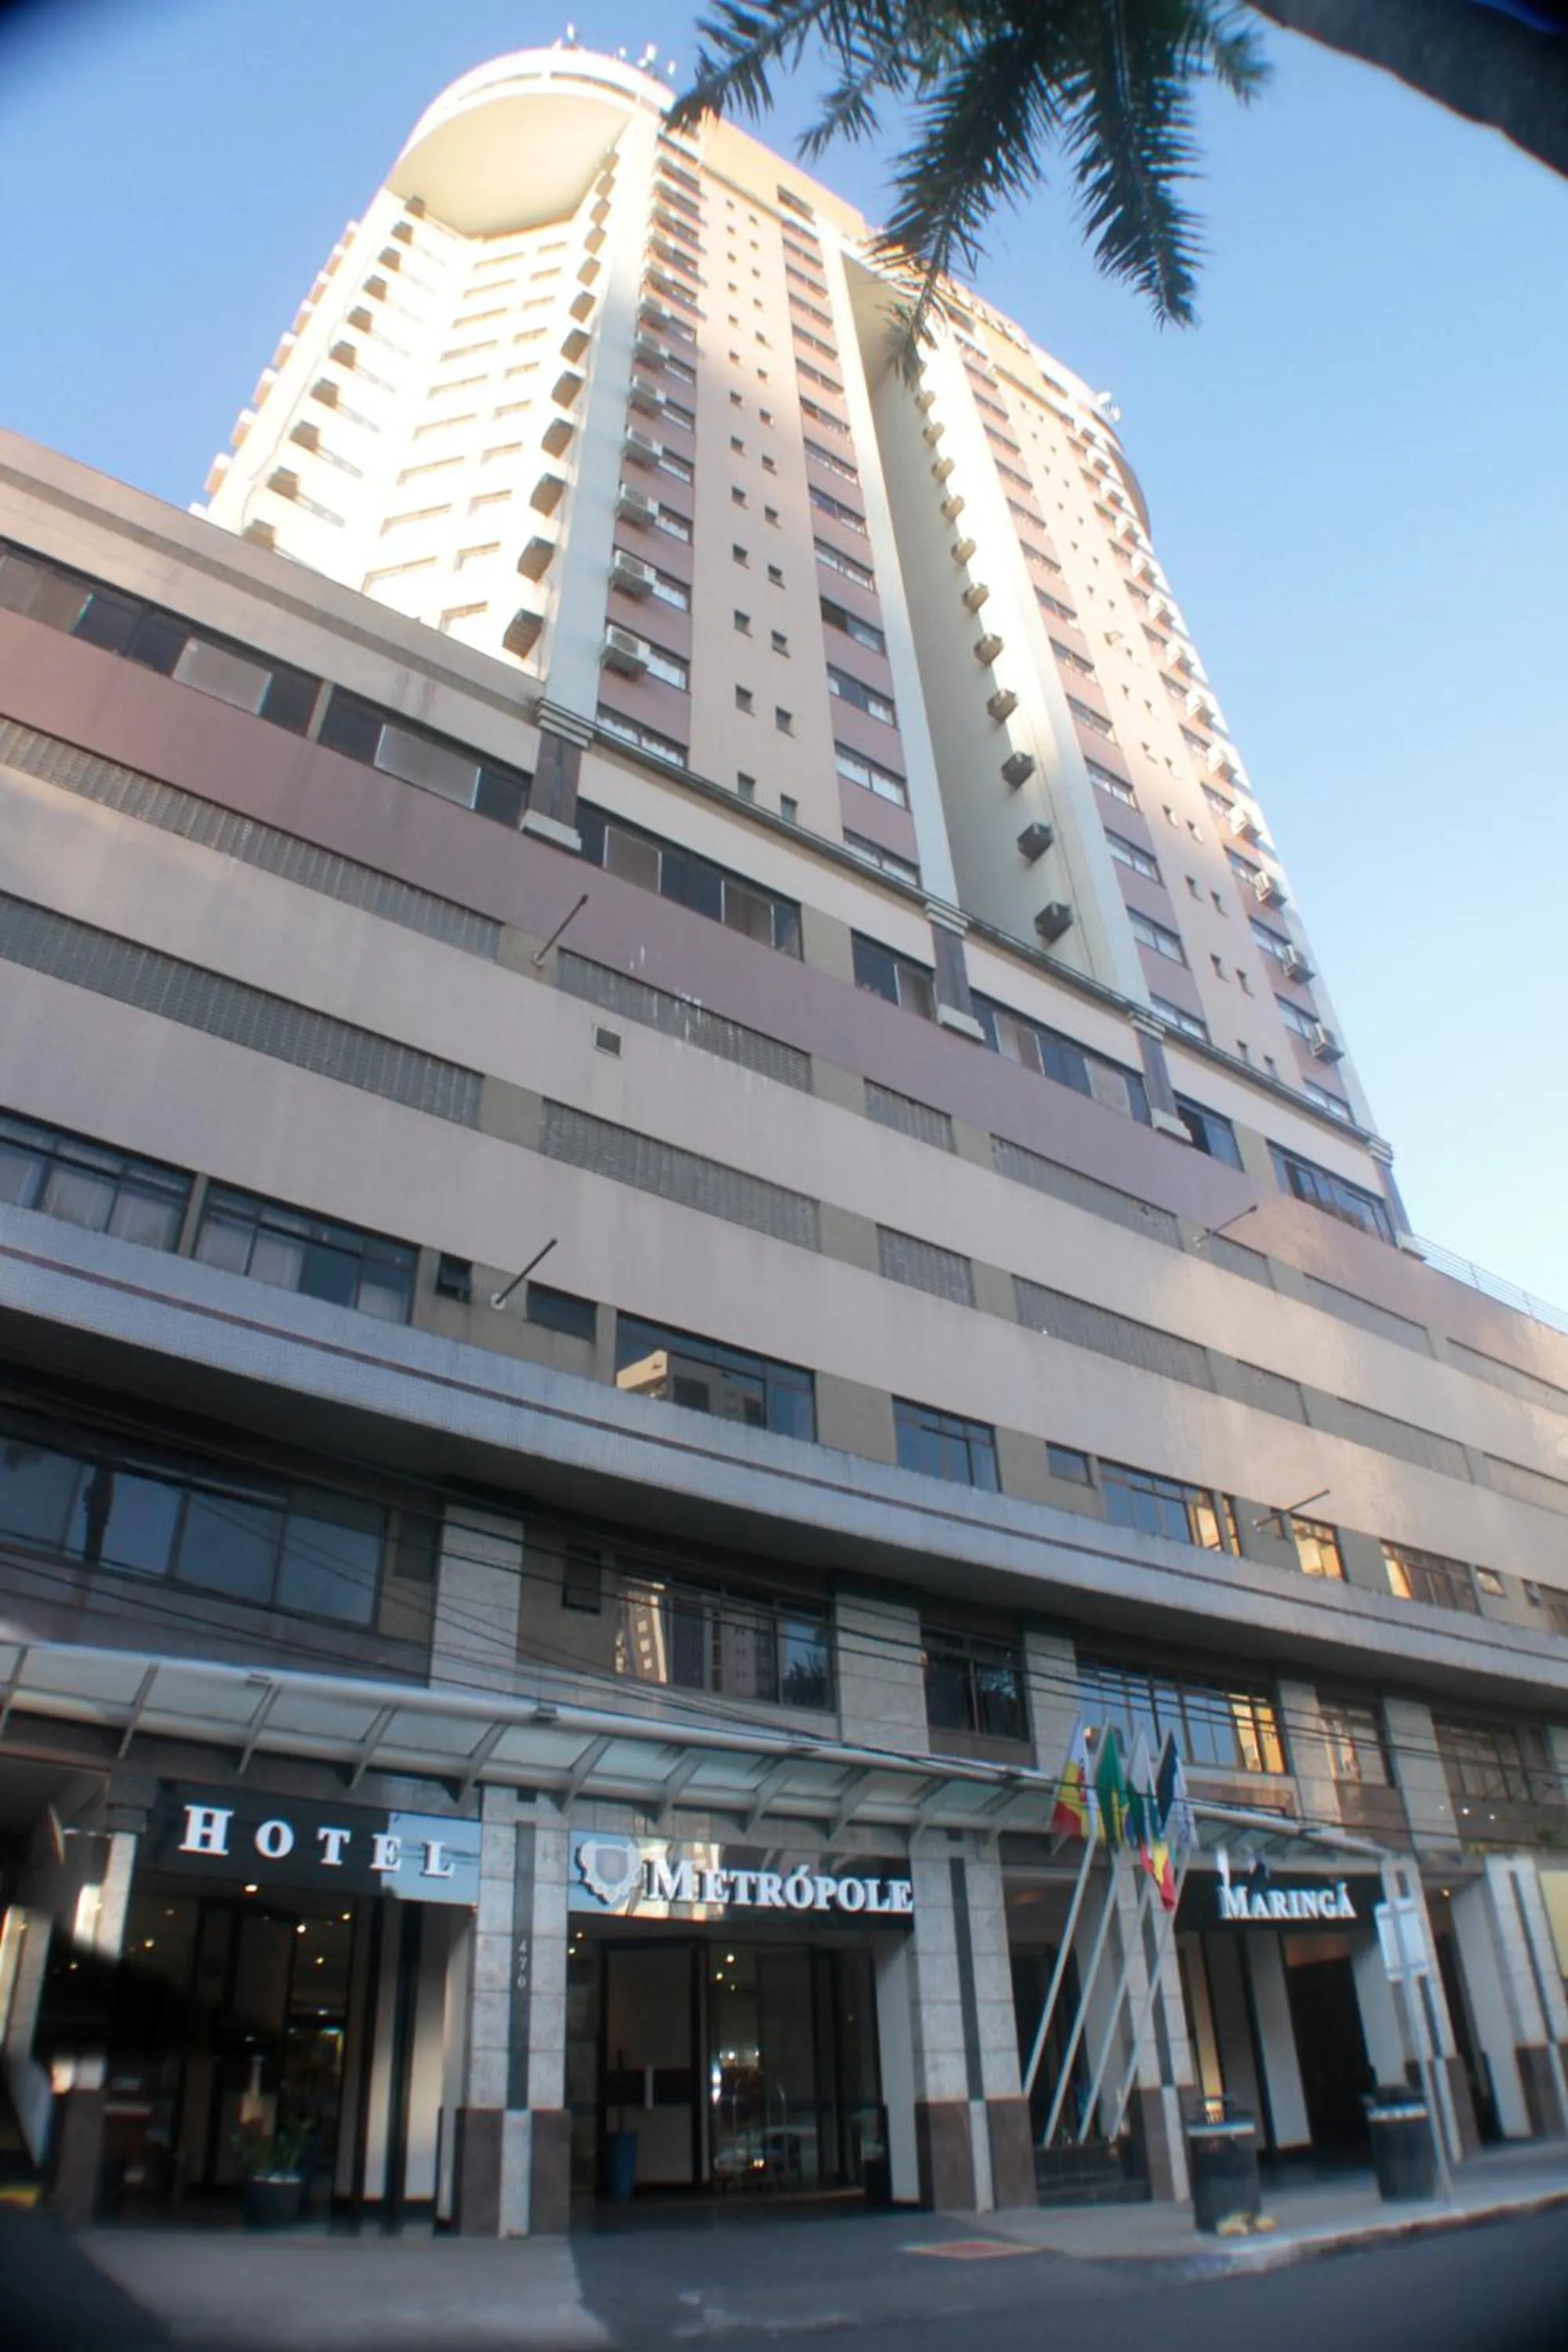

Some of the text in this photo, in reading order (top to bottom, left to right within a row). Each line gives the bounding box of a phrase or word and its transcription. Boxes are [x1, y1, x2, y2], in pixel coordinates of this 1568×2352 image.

[179, 1804, 455, 1878] HOTEL
[644, 1857, 913, 1913] METRÓPOLE
[1218, 1881, 1357, 1920] MARINGÁ
